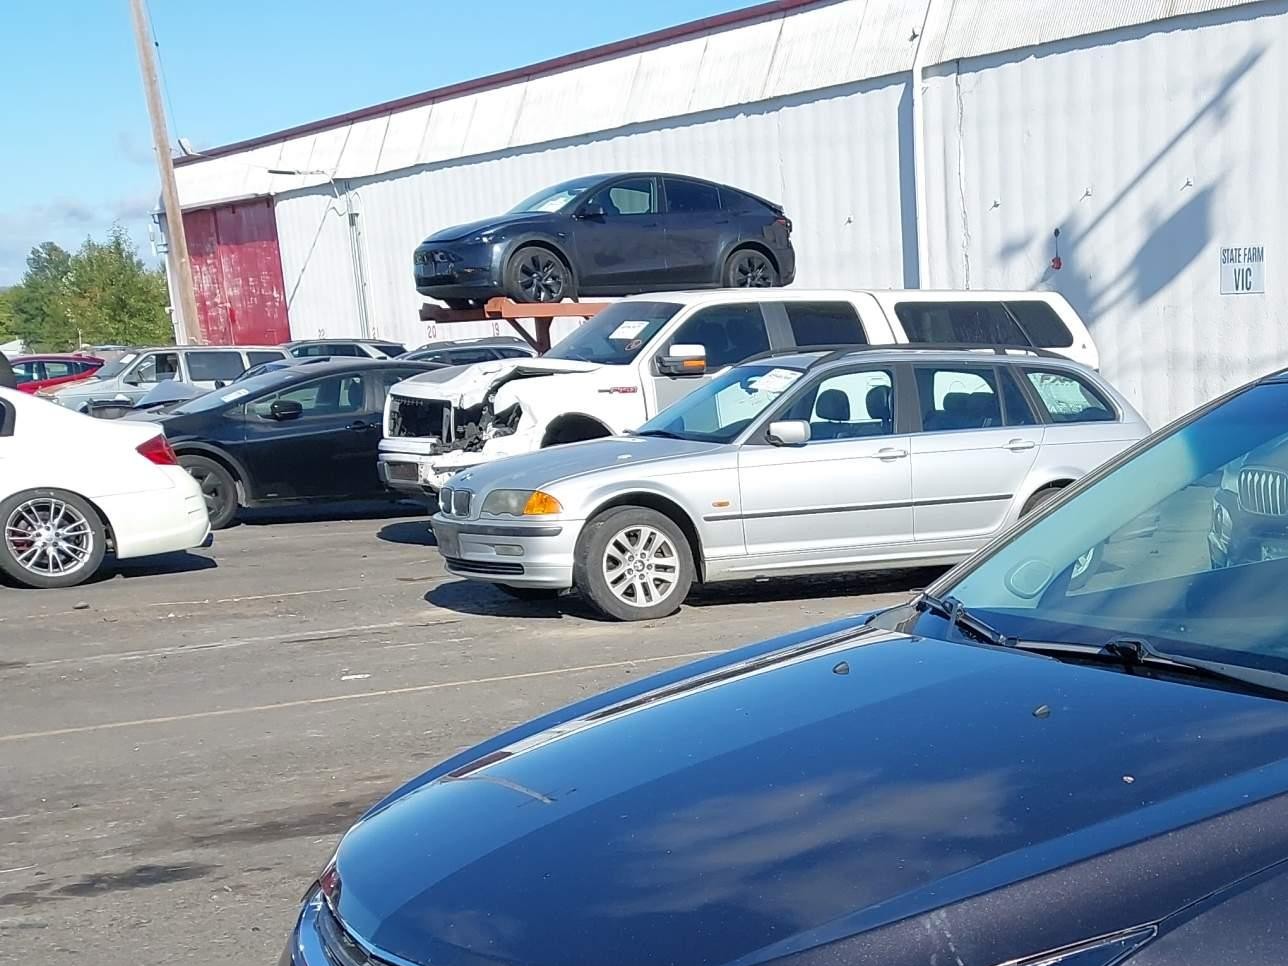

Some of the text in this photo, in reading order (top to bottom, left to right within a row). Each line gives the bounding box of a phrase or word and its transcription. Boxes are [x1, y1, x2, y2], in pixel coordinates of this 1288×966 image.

[1222, 246, 1264, 264] STATE FARM
[1233, 267, 1252, 291] VIC
[427, 325, 437, 339] 20
[492, 321, 500, 336] 19
